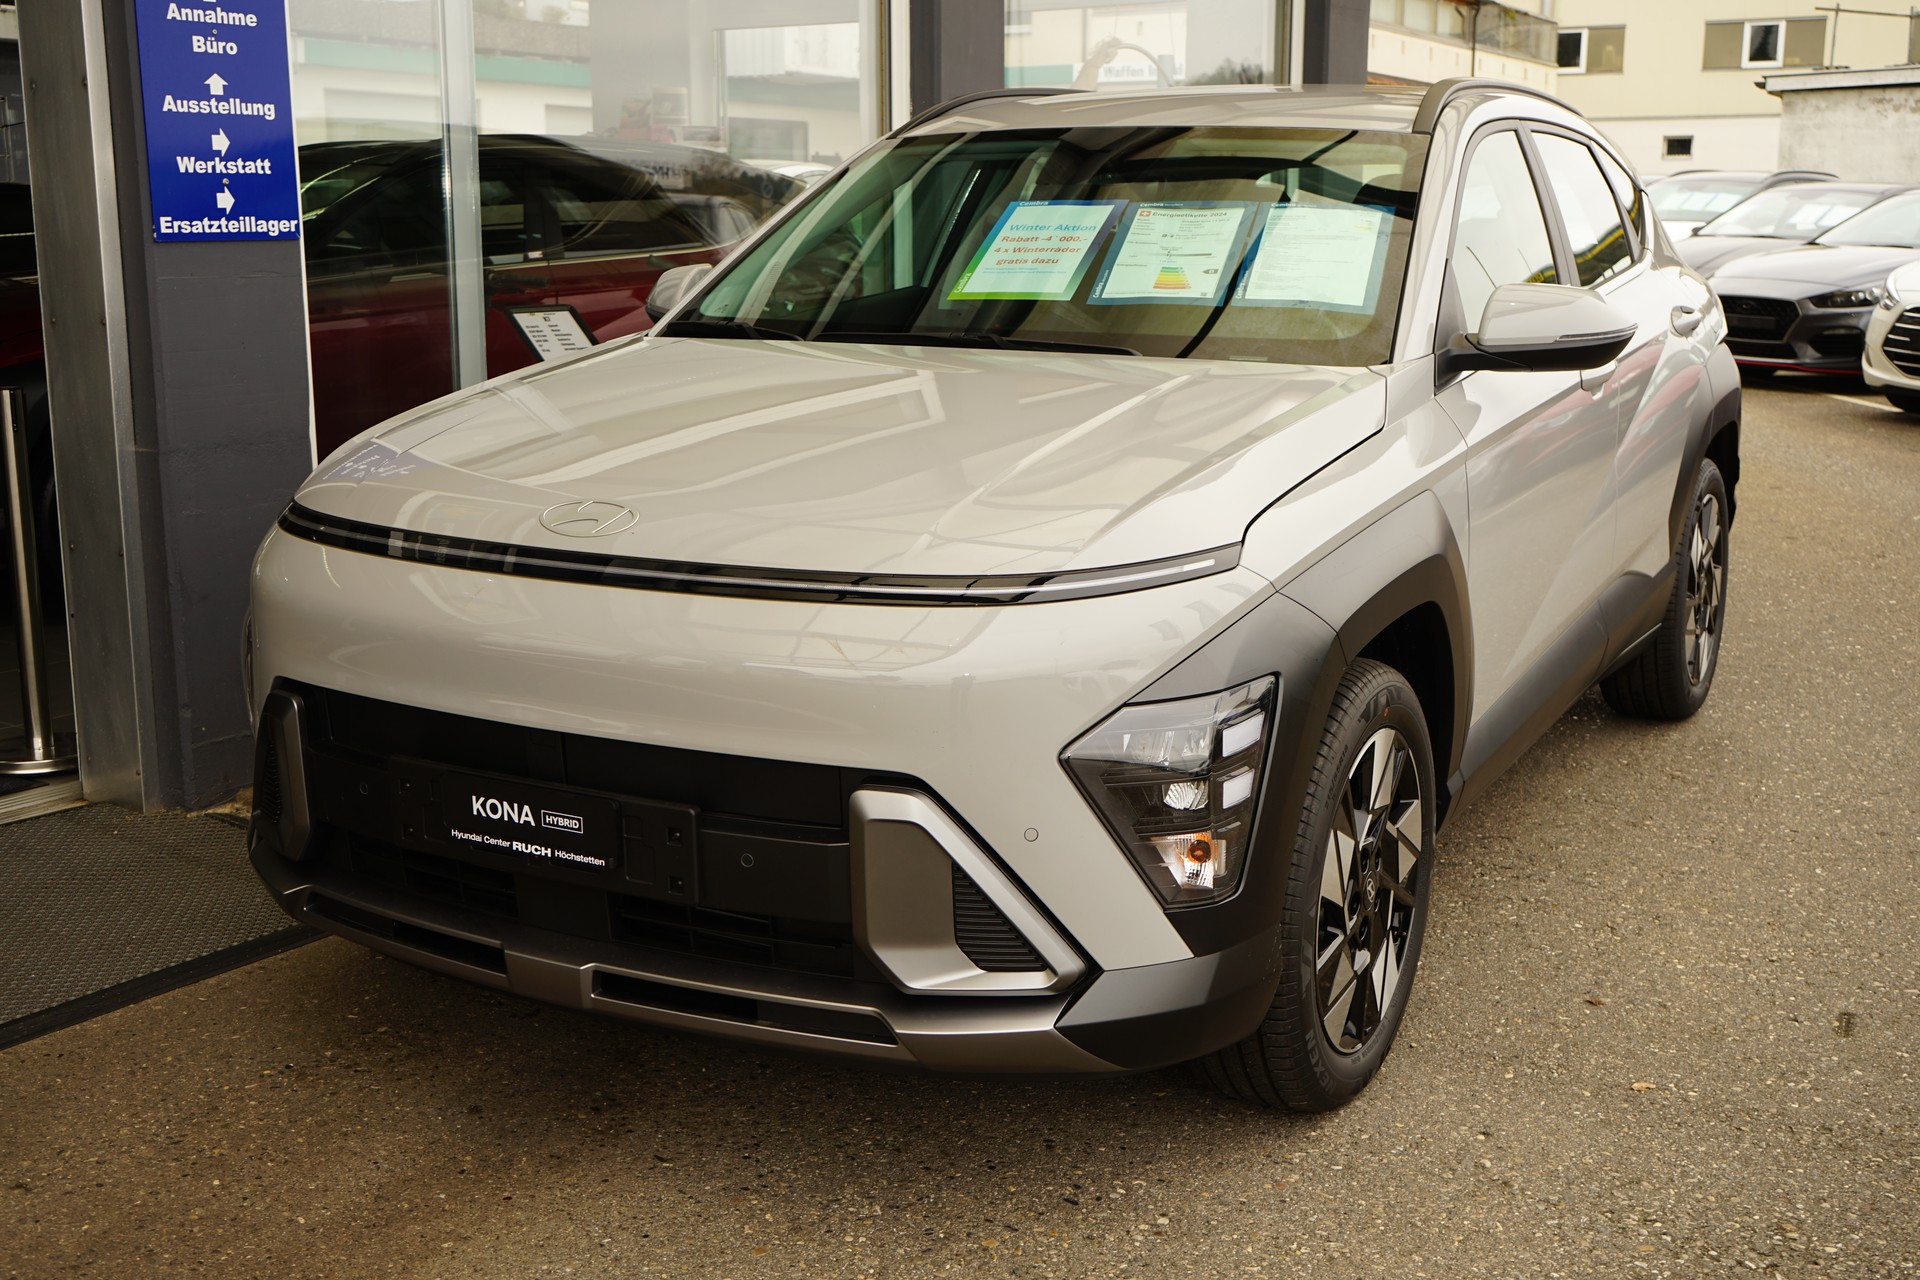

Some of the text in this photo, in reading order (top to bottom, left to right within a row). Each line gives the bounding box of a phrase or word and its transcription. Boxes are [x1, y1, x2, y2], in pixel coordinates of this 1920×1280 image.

[166, 2, 258, 27] Annahme
[191, 35, 238, 55] Büro
[162, 95, 276, 120] Ausstellung
[176, 156, 272, 175] Werkstatt
[159, 216, 299, 236] Ersatzteillager
[1010, 223, 1097, 232] Winter Aktion
[996, 257, 1060, 266] gratis dazu
[471, 795, 580, 829] KONA HYBRID
[451, 829, 606, 866] Hyundai Center RUCH Höchstetten
